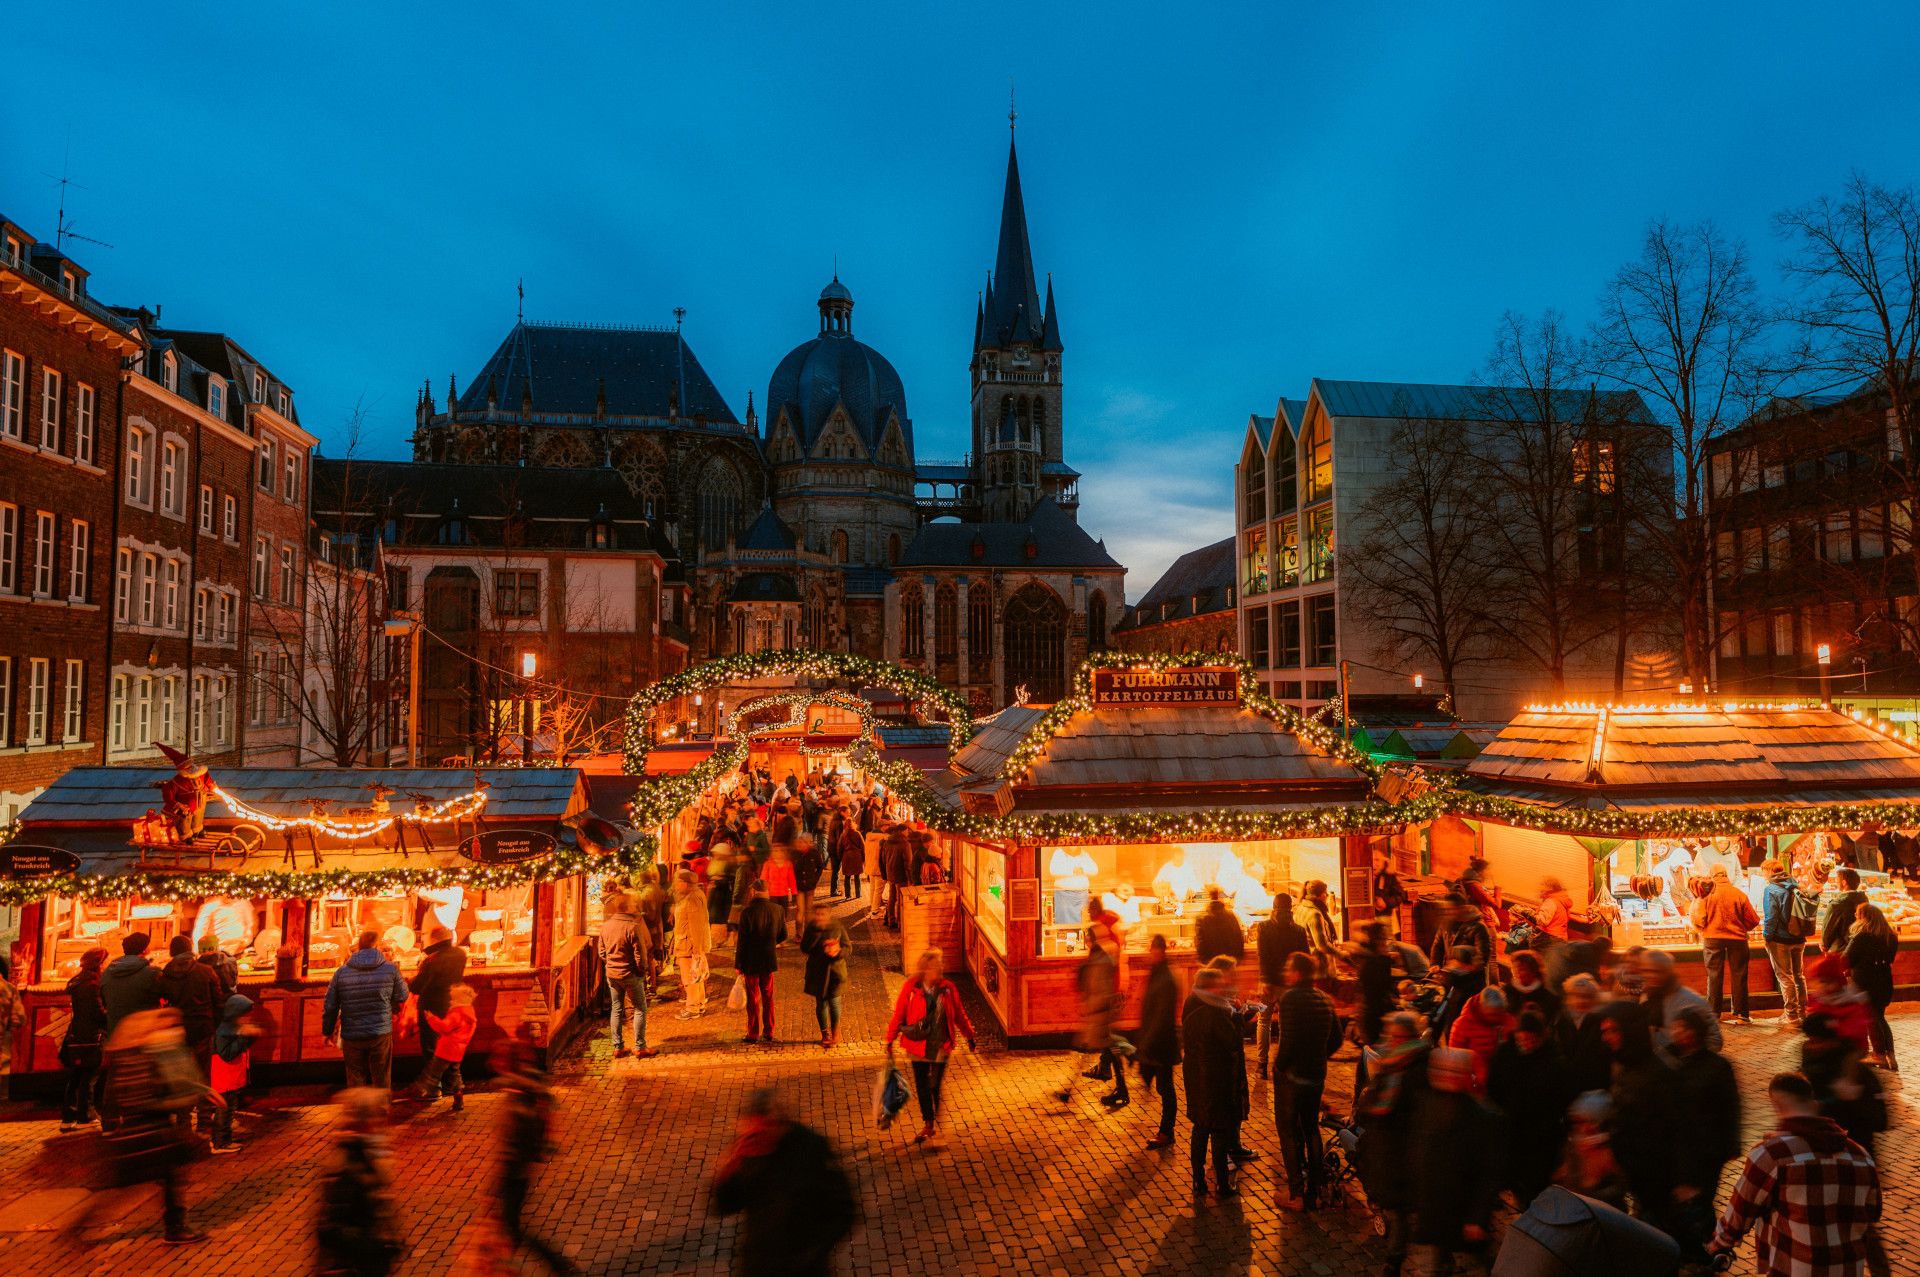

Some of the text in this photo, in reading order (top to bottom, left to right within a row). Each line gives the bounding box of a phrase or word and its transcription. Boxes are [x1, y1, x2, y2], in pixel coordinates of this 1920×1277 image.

[1111, 672, 1222, 688] FUHRMANN
[1099, 690, 1234, 702] KARTOFFELHAUS
[12, 855, 37, 863] Nougat
